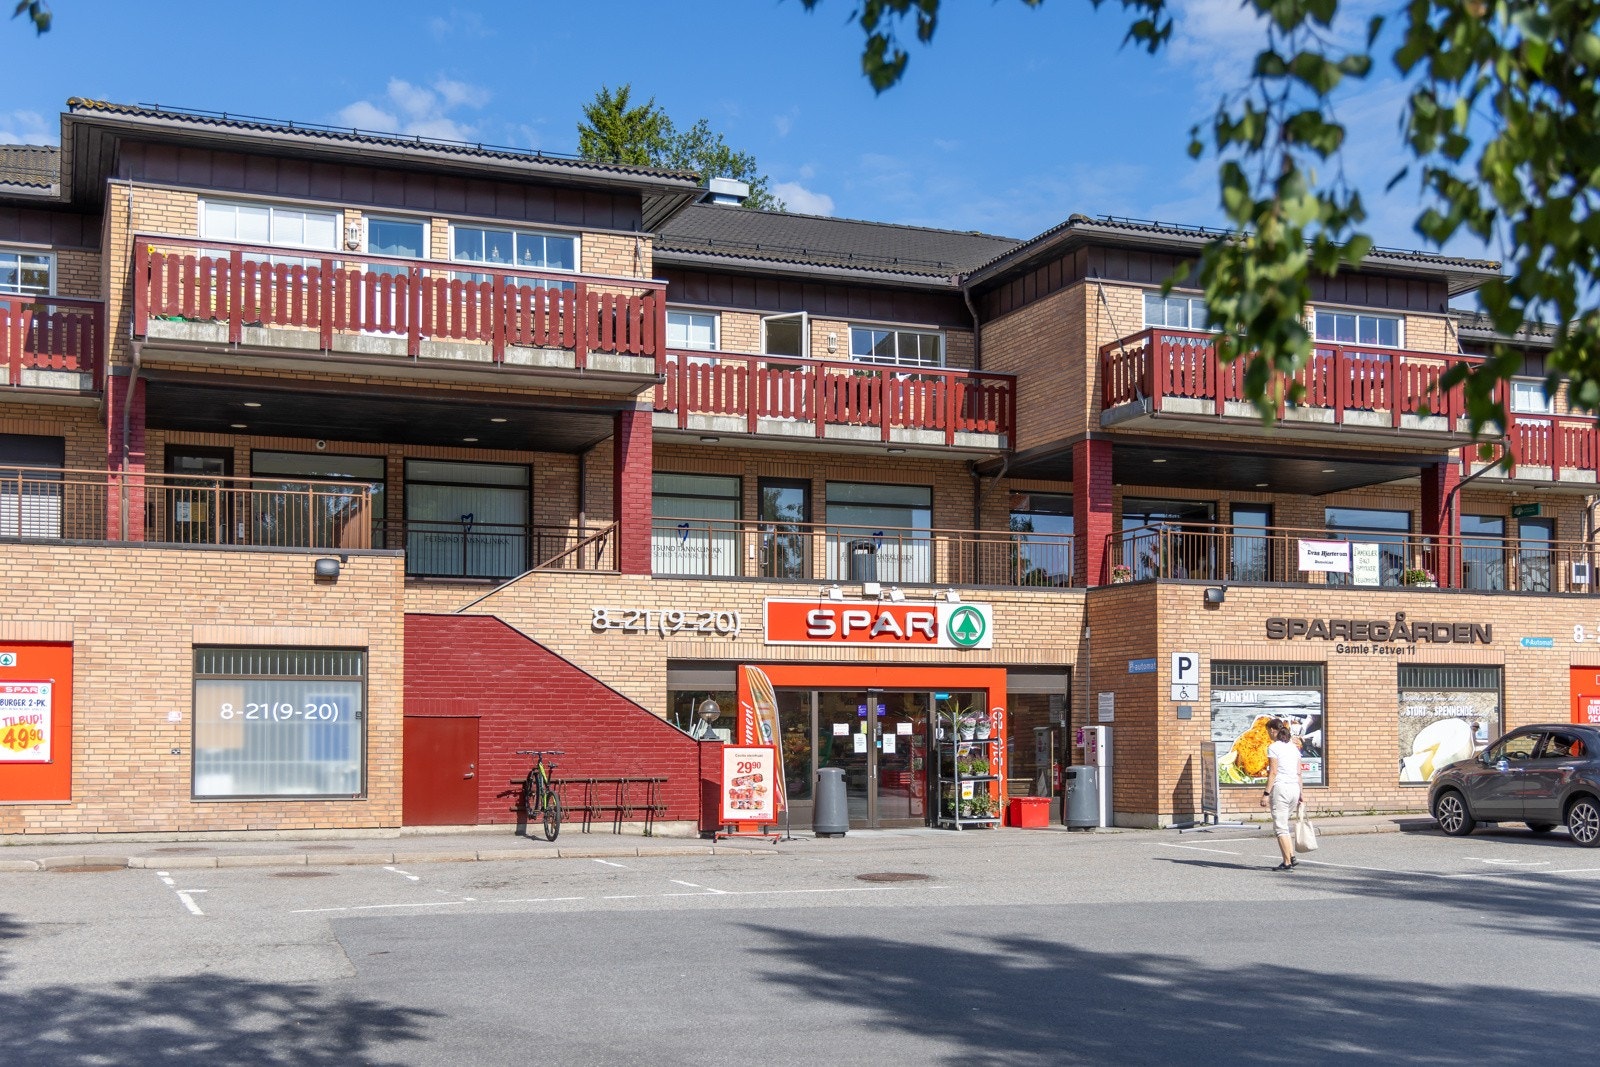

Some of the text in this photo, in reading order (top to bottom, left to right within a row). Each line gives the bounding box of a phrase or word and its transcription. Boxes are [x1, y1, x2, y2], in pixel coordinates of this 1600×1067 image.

[807, 609, 938, 639] SPAR
[1265, 612, 1493, 644] SPAREGÅRDEN
[1336, 643, 1416, 655] Gamle Fetvei 11
[1178, 656, 1192, 680] P
[2, 714, 43, 727] TILBUD!
